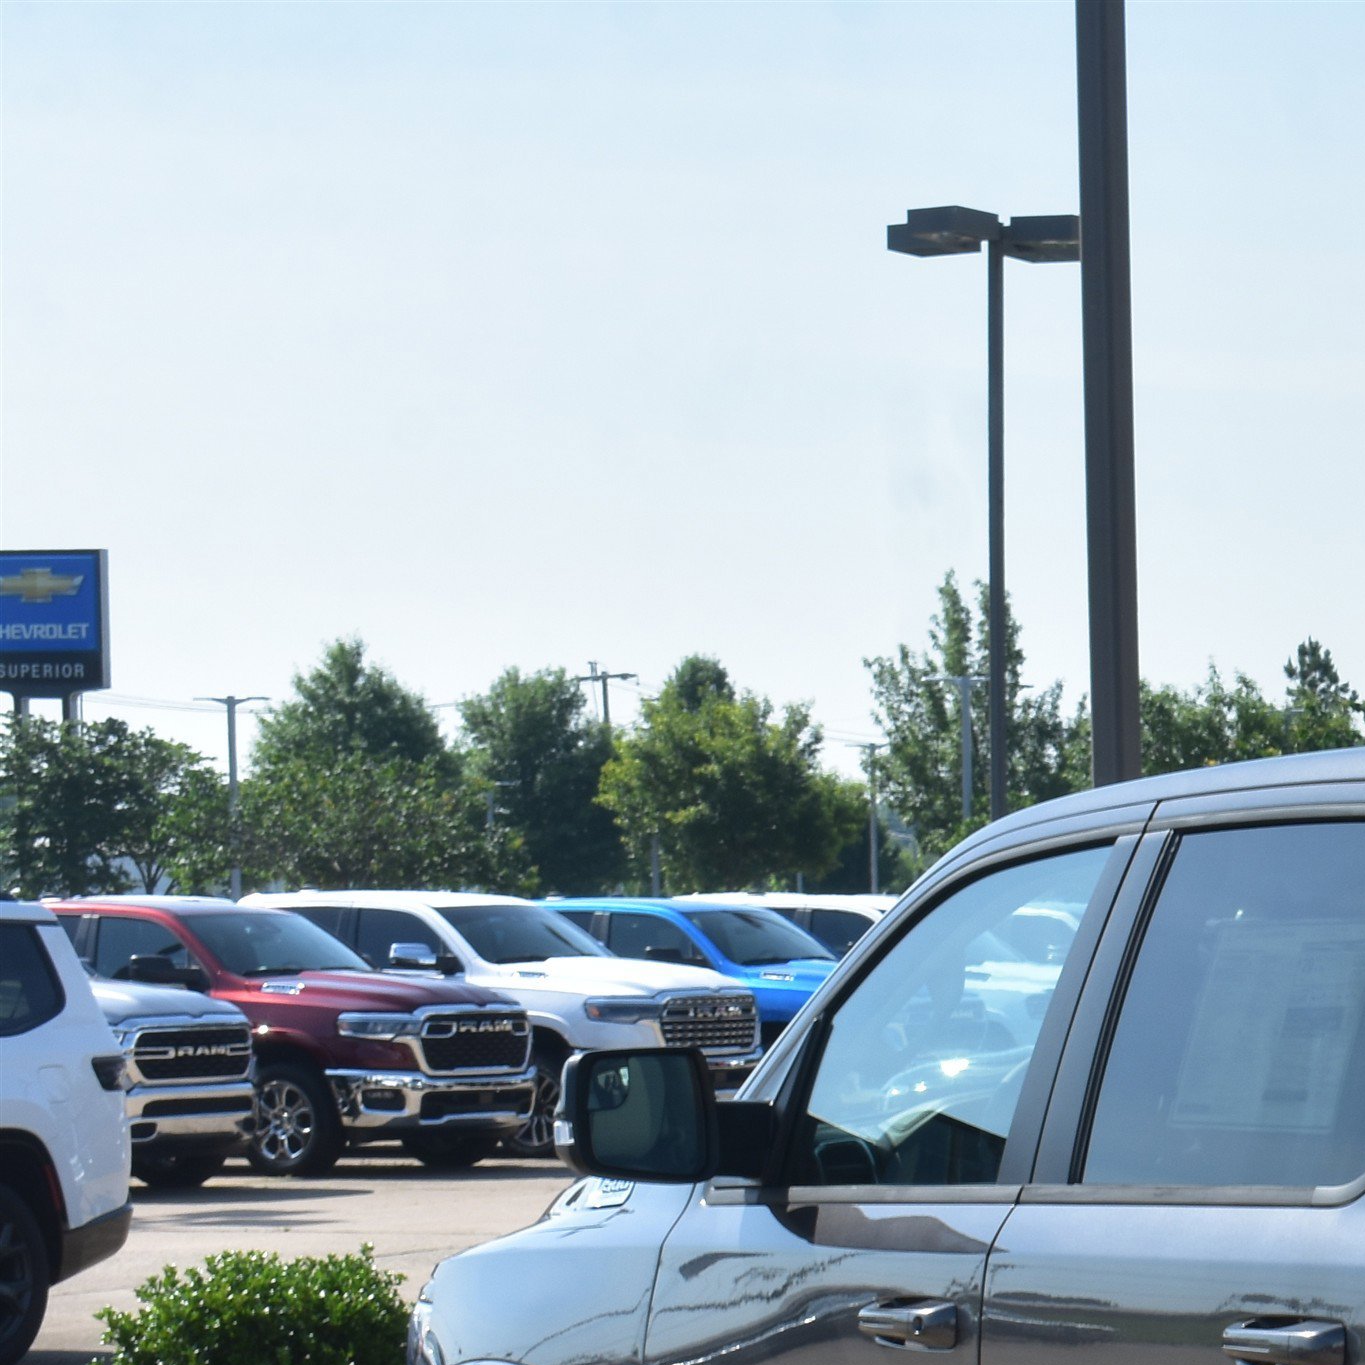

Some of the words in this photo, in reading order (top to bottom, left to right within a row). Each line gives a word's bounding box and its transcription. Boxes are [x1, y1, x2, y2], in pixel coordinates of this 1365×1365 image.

[0, 623, 89, 640] HEVROLET
[0, 663, 84, 678] SUPERIOR
[459, 1020, 512, 1033] RAM
[177, 1046, 230, 1057] RAM
